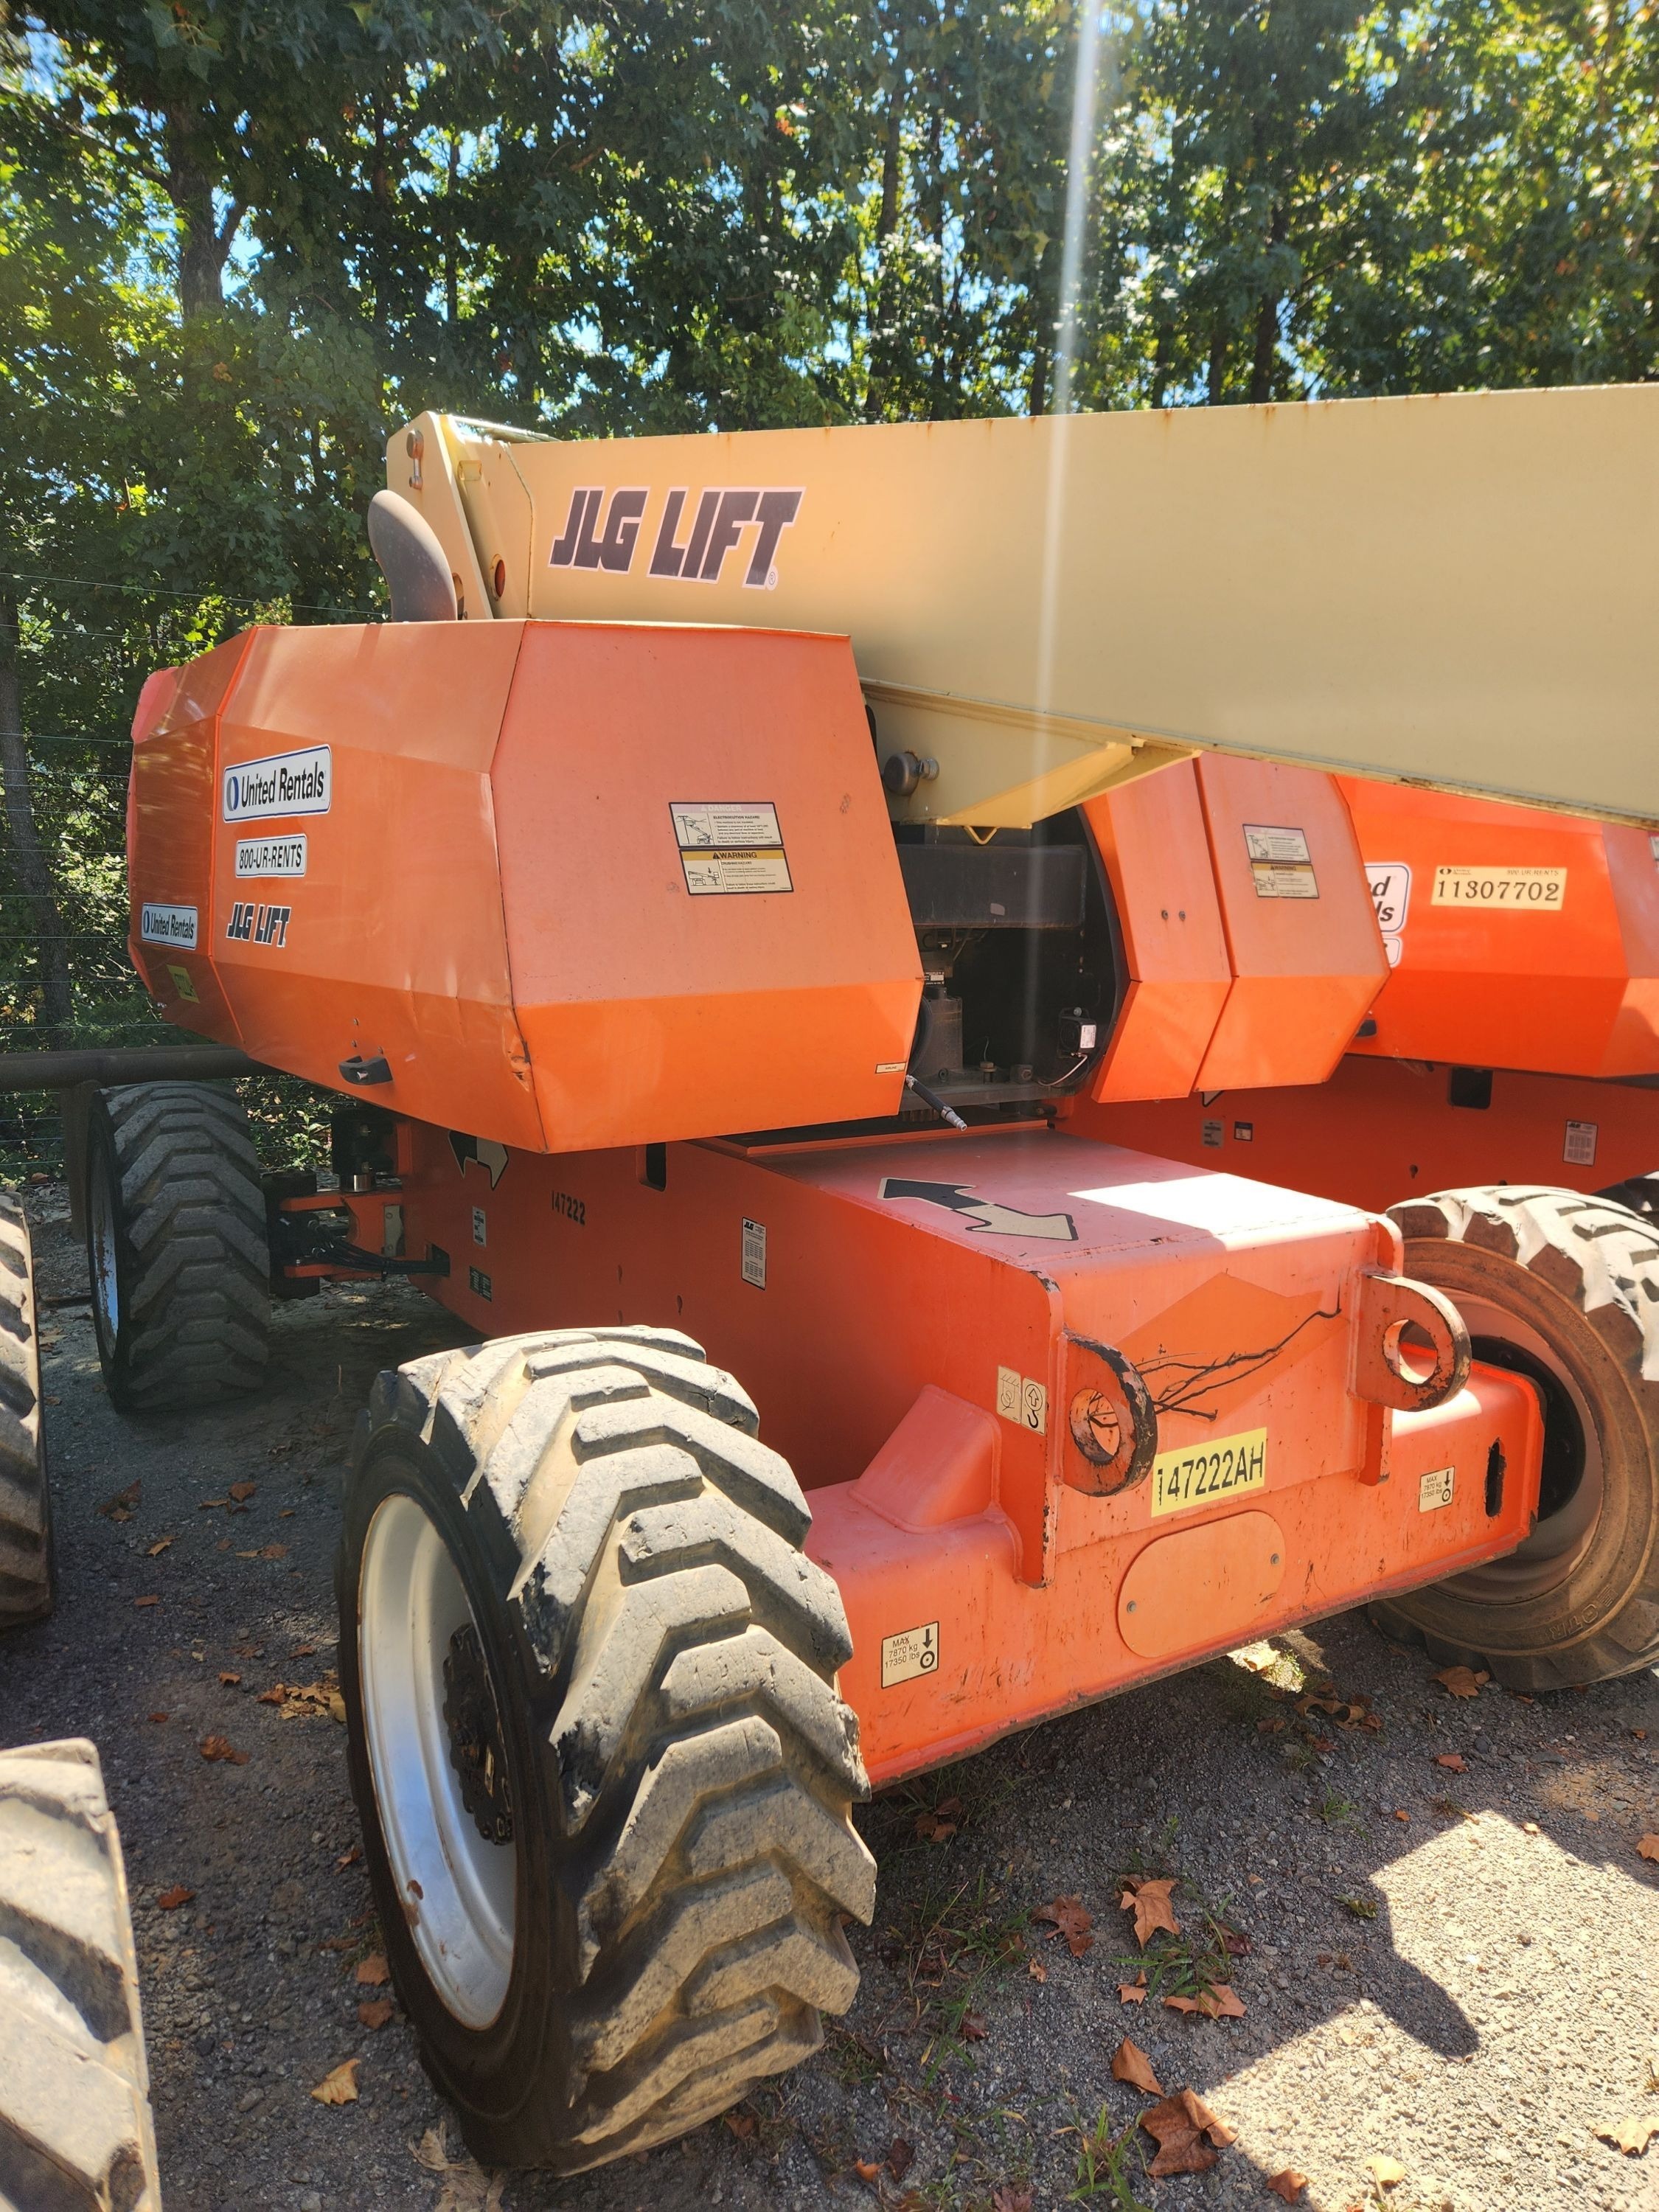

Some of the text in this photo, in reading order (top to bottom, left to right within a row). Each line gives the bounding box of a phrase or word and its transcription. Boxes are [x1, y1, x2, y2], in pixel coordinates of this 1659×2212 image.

[550, 489, 803, 585] JLG LIFT
[241, 762, 324, 807] United Rentals
[240, 844, 302, 869] 800-UR-RENTS
[1438, 880, 1559, 901] 11307702
[150, 912, 194, 939] United Rentals
[227, 903, 291, 946] JLG LIFT
[552, 1189, 585, 1225] 147222
[1157, 1441, 1265, 1506] 147222AH
[888, 1644, 918, 1658] 7870 kg
[892, 1635, 910, 1648] MAX
[885, 1652, 920, 1669] 17350 lbs
